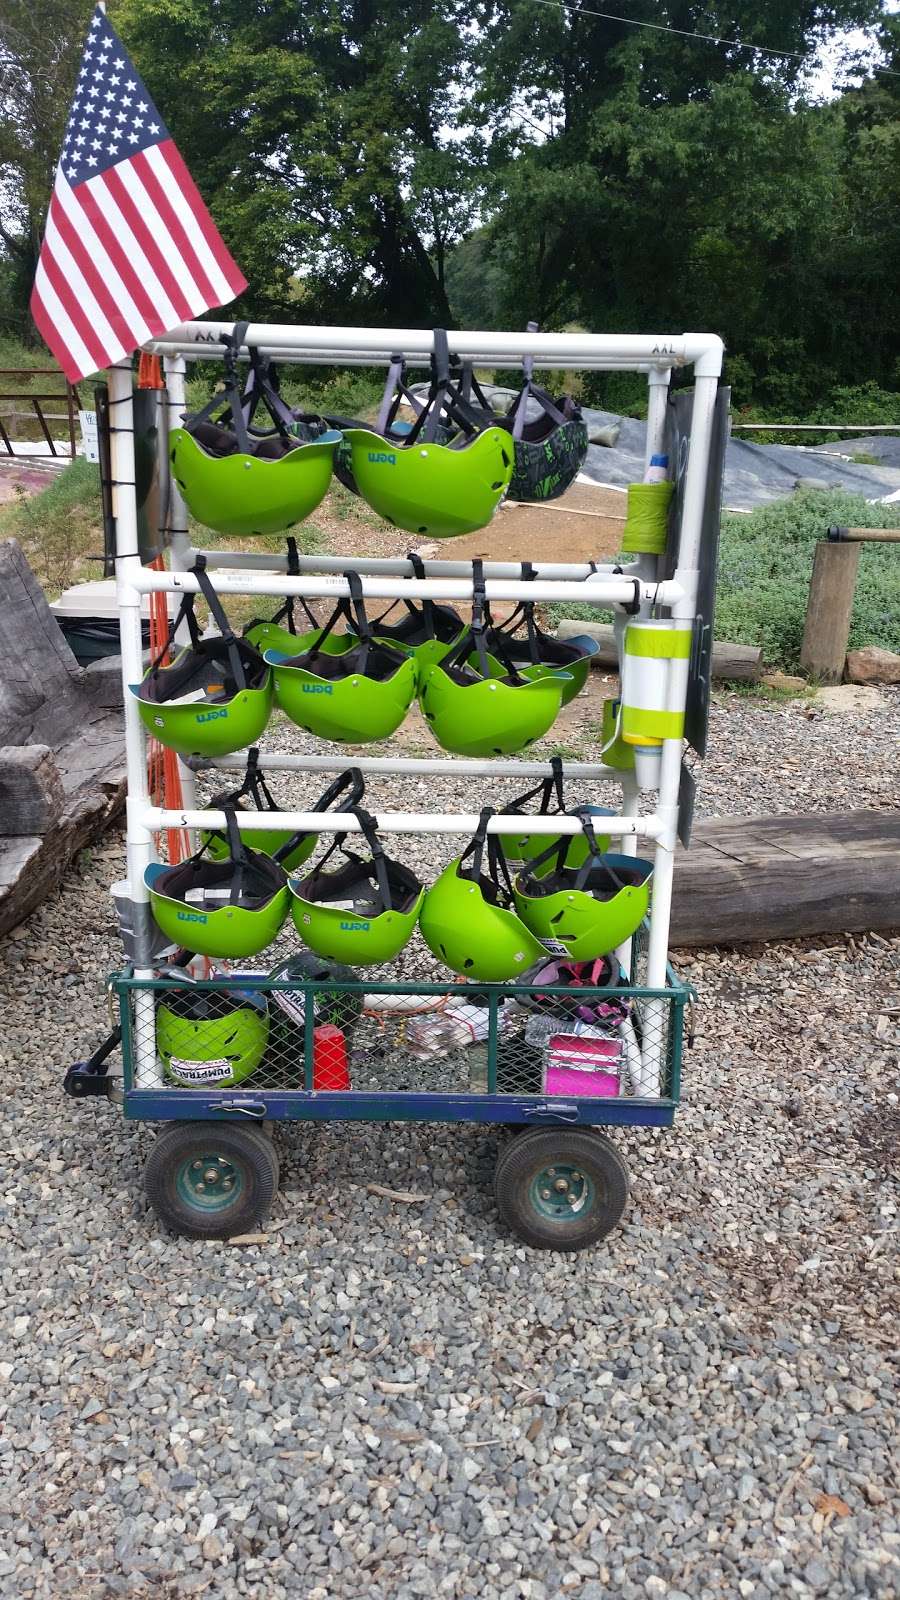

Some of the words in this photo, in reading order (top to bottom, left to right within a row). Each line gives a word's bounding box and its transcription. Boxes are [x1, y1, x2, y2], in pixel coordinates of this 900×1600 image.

[368, 452, 397, 465] bern
[173, 575, 181, 586] L
[645, 589, 652, 599] L
[303, 683, 333, 695] bern
[196, 709, 228, 723] bern
[180, 814, 188, 826] S
[177, 911, 209, 925] bern
[340, 922, 370, 932] bern
